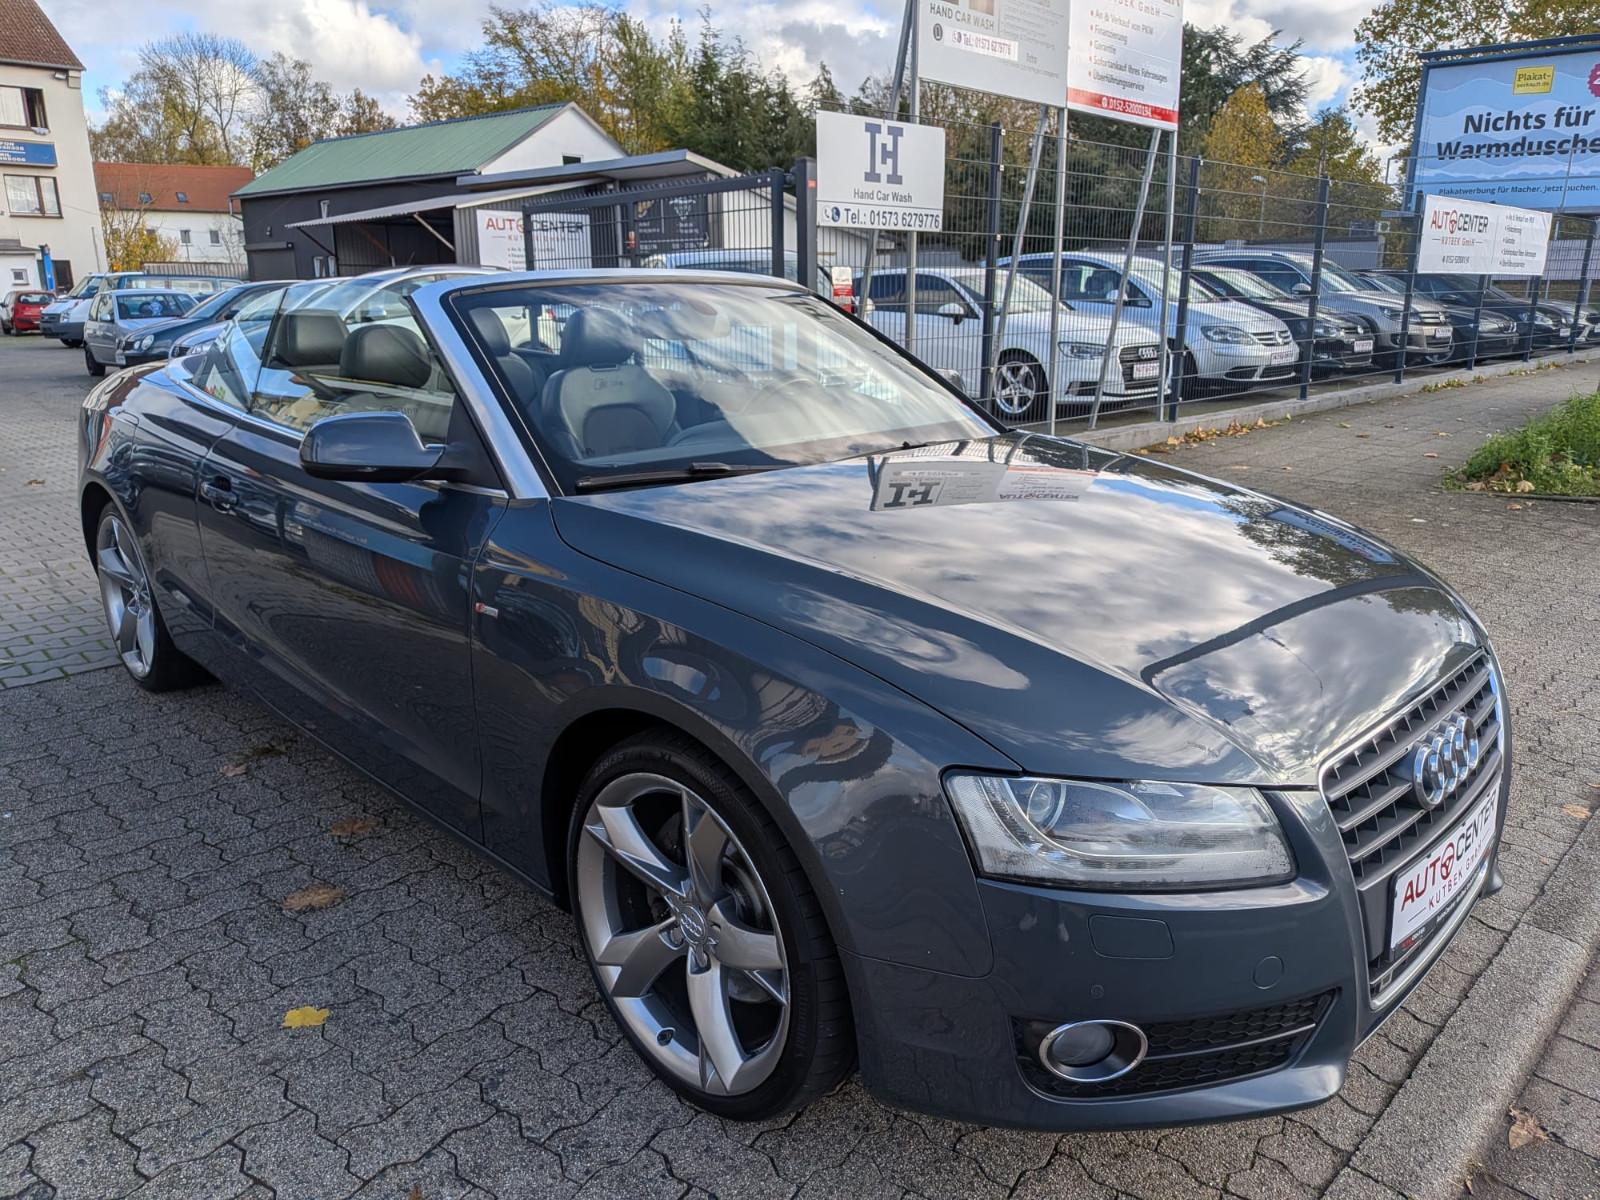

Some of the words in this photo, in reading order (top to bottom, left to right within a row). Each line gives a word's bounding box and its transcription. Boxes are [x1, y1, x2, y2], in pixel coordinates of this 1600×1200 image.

[930, 3, 953, 19] HAND
[955, 11, 971, 24] CAR
[973, 16, 994, 31] WASH
[1518, 72, 1551, 82] Plakat-
[1463, 110, 1546, 134] Nichts
[1553, 106, 1596, 128] für
[853, 188, 873, 201] Hand
[875, 190, 890, 202] Car
[891, 191, 913, 204] Wash
[1438, 187, 1495, 196] Plakatwerbung
[1510, 185, 1541, 193] Macher.
[844, 208, 867, 225] Tel.:
[869, 210, 899, 227] 01573
[901, 212, 940, 229] 6279776
[1428, 868, 1463, 910] KUTBEK
